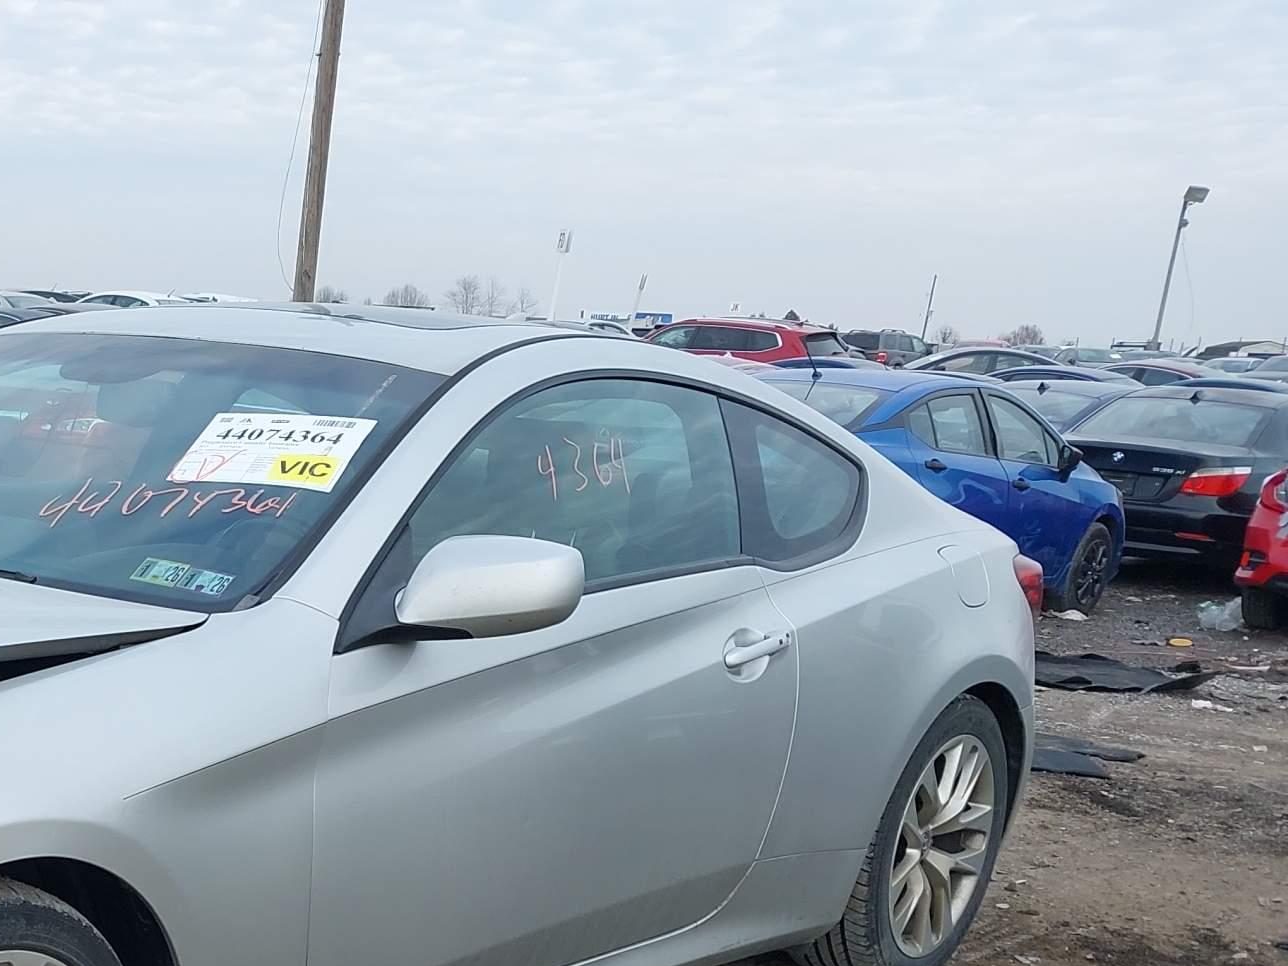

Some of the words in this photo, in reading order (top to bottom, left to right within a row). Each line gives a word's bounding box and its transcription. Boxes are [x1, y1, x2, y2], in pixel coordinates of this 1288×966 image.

[216, 427, 344, 445] 44074364
[280, 460, 332, 478] VIC
[537, 437, 631, 501] 4364
[209, 576, 231, 593] 26
